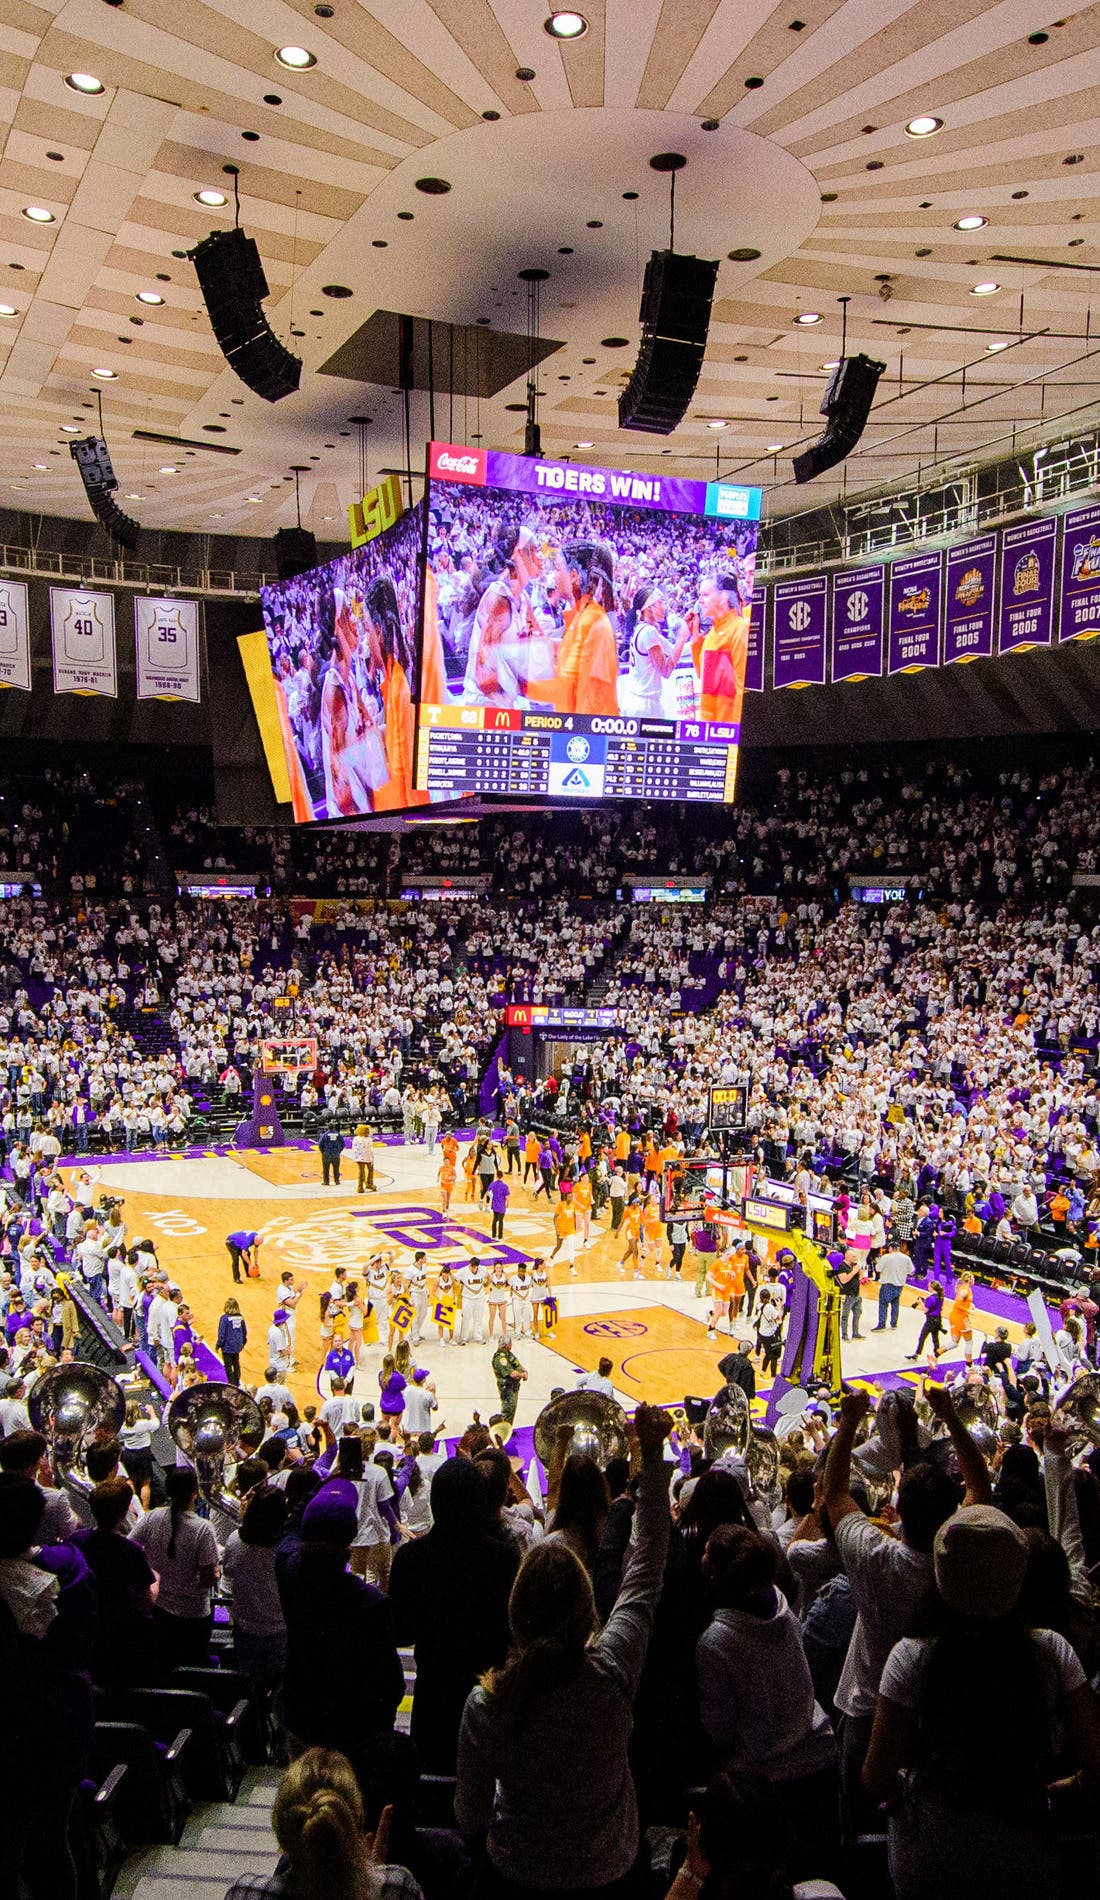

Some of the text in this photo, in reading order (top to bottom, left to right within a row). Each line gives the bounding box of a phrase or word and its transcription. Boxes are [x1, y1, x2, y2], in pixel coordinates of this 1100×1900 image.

[437, 453, 479, 474] Coca-Cola
[535, 466, 660, 501] TIGERS WIN!
[349, 475, 404, 549] LSU
[846, 591, 869, 622] SEC
[1071, 597, 1089, 608] FINAL
[788, 601, 811, 631] SEC
[1010, 607, 1042, 622] FINAL FOUR
[74, 619, 93, 636] 40
[158, 627, 177, 643] 35
[953, 621, 983, 634] FINAL FOUR
[1012, 619, 1037, 636] 2006
[899, 633, 930, 645] FINAL FOUR
[956, 631, 979, 648] 2005
[902, 643, 926, 659] 2004
[427, 707, 441, 723] T
[524, 715, 574, 730] PERIOD 4
[591, 717, 638, 735] 0:00.0
[685, 724, 700, 737] 76
[709, 726, 735, 739] LSU
[747, 1205, 768, 1218] LSU
[142, 1209, 208, 1237] COX
[349, 1207, 535, 1270] LSU
[393, 1305, 413, 1329] G
[434, 1303, 453, 1326] E
